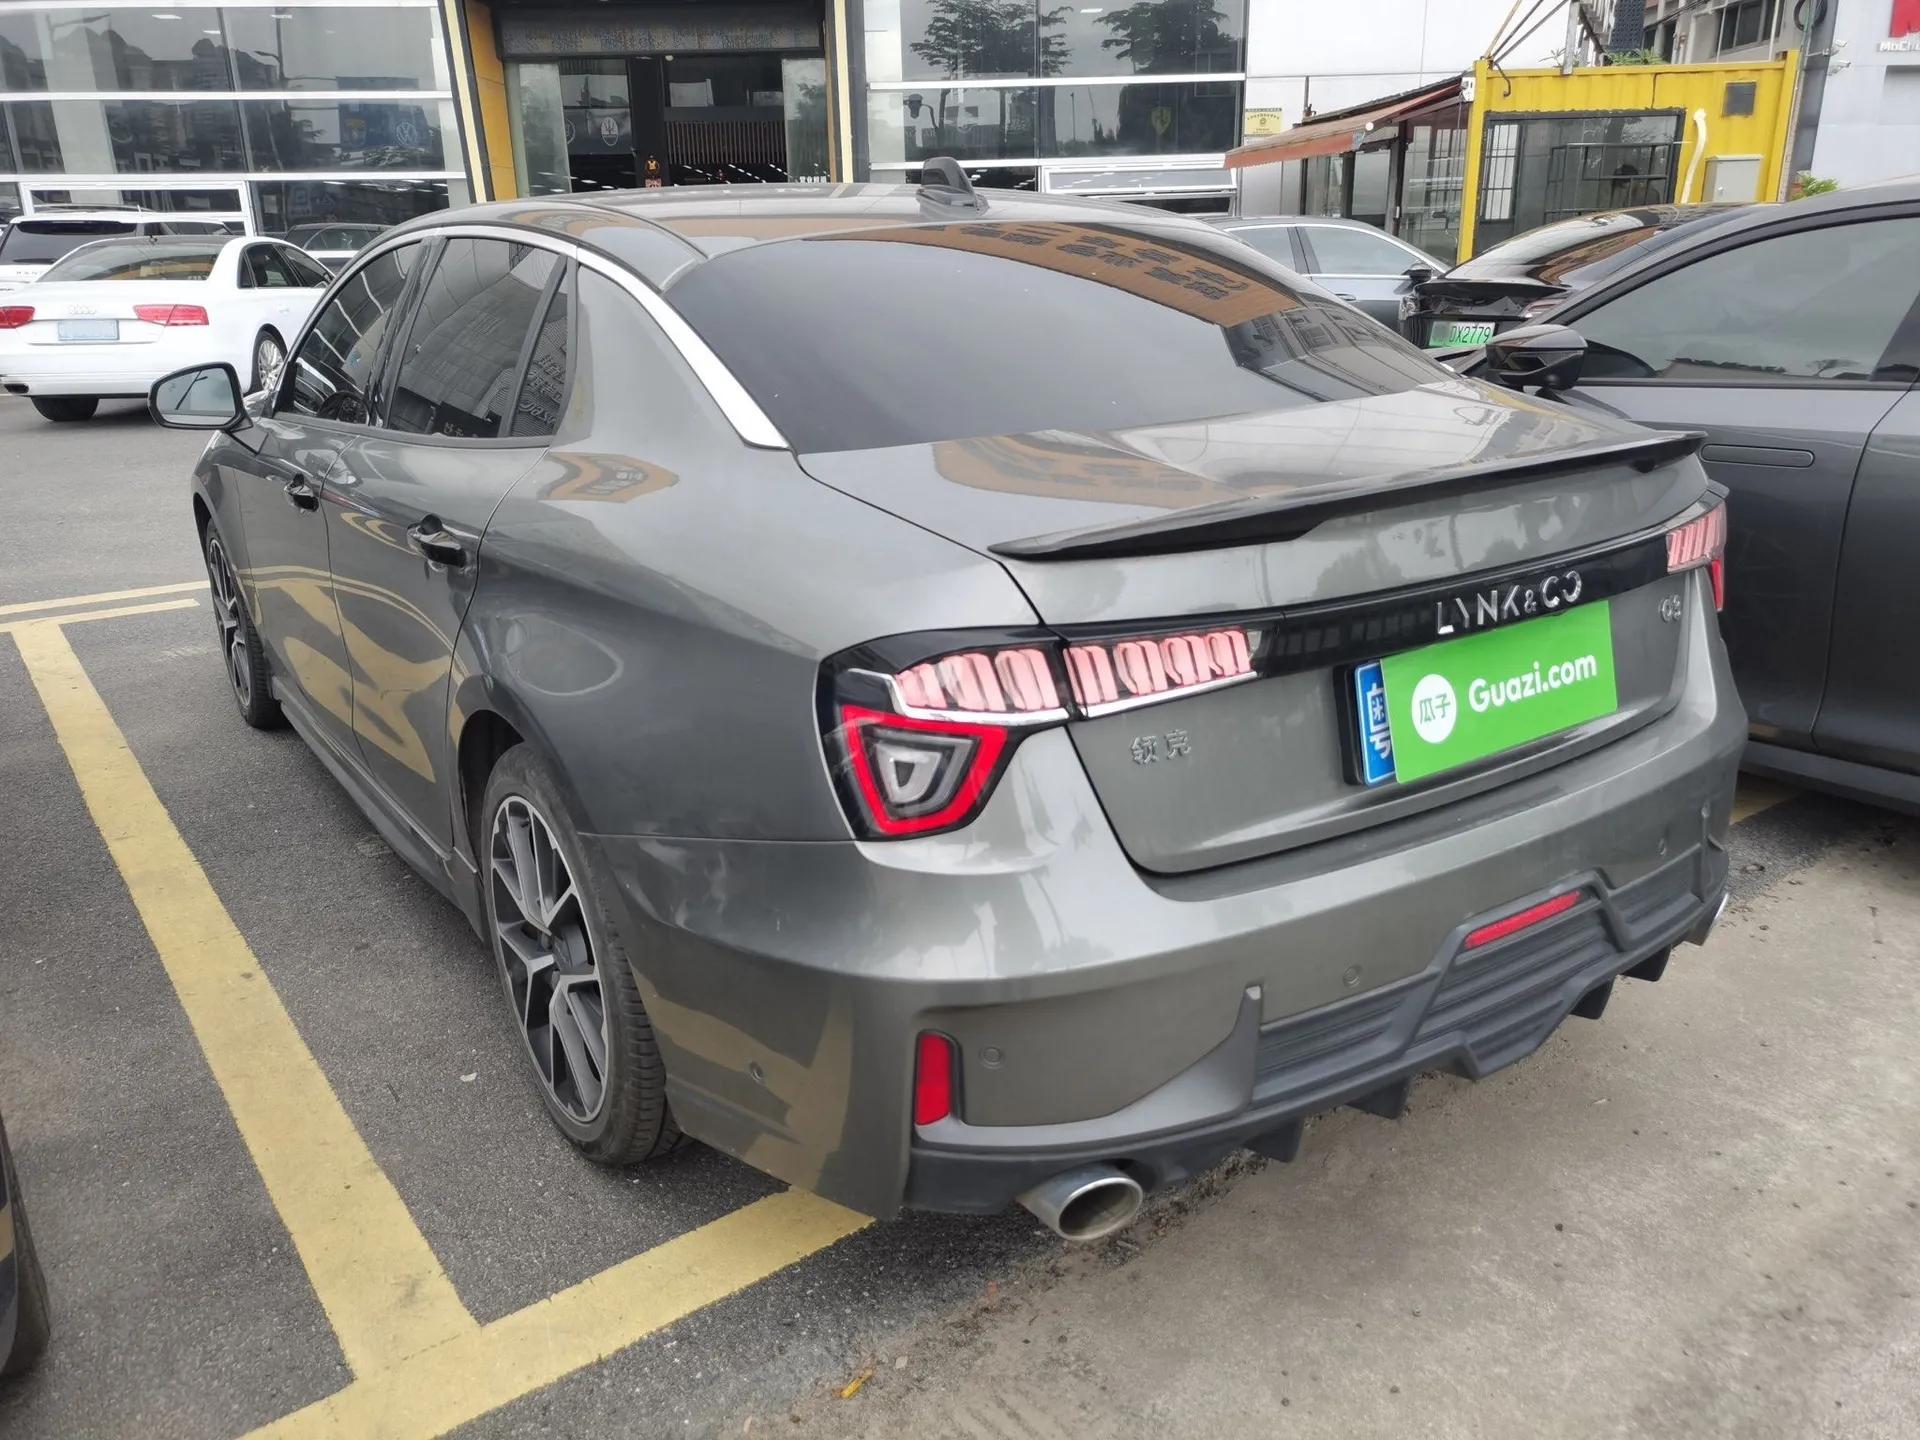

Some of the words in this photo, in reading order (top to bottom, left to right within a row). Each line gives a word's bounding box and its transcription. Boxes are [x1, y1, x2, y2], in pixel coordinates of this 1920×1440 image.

[1449, 325, 1491, 344] DX2779
[1468, 654, 1597, 713] Guazi.com
[1418, 692, 1452, 725] 瓜子
[1130, 729, 1192, 765] 领克
